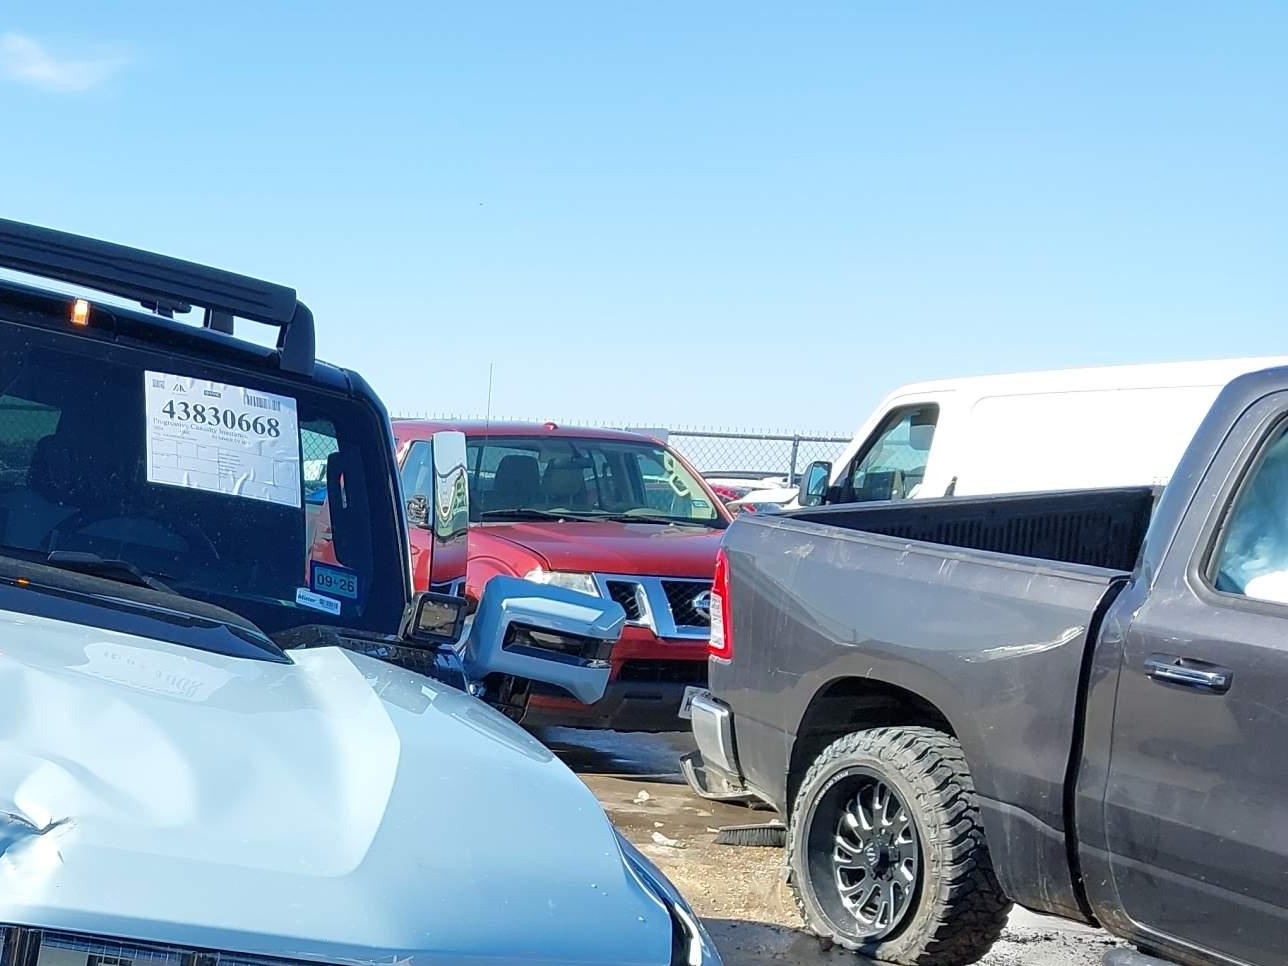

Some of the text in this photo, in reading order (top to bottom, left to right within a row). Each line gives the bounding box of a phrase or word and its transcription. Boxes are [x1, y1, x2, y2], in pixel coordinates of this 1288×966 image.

[162, 400, 280, 438] 43830668
[317, 574, 333, 588] 09
[339, 579, 354, 592] 26
